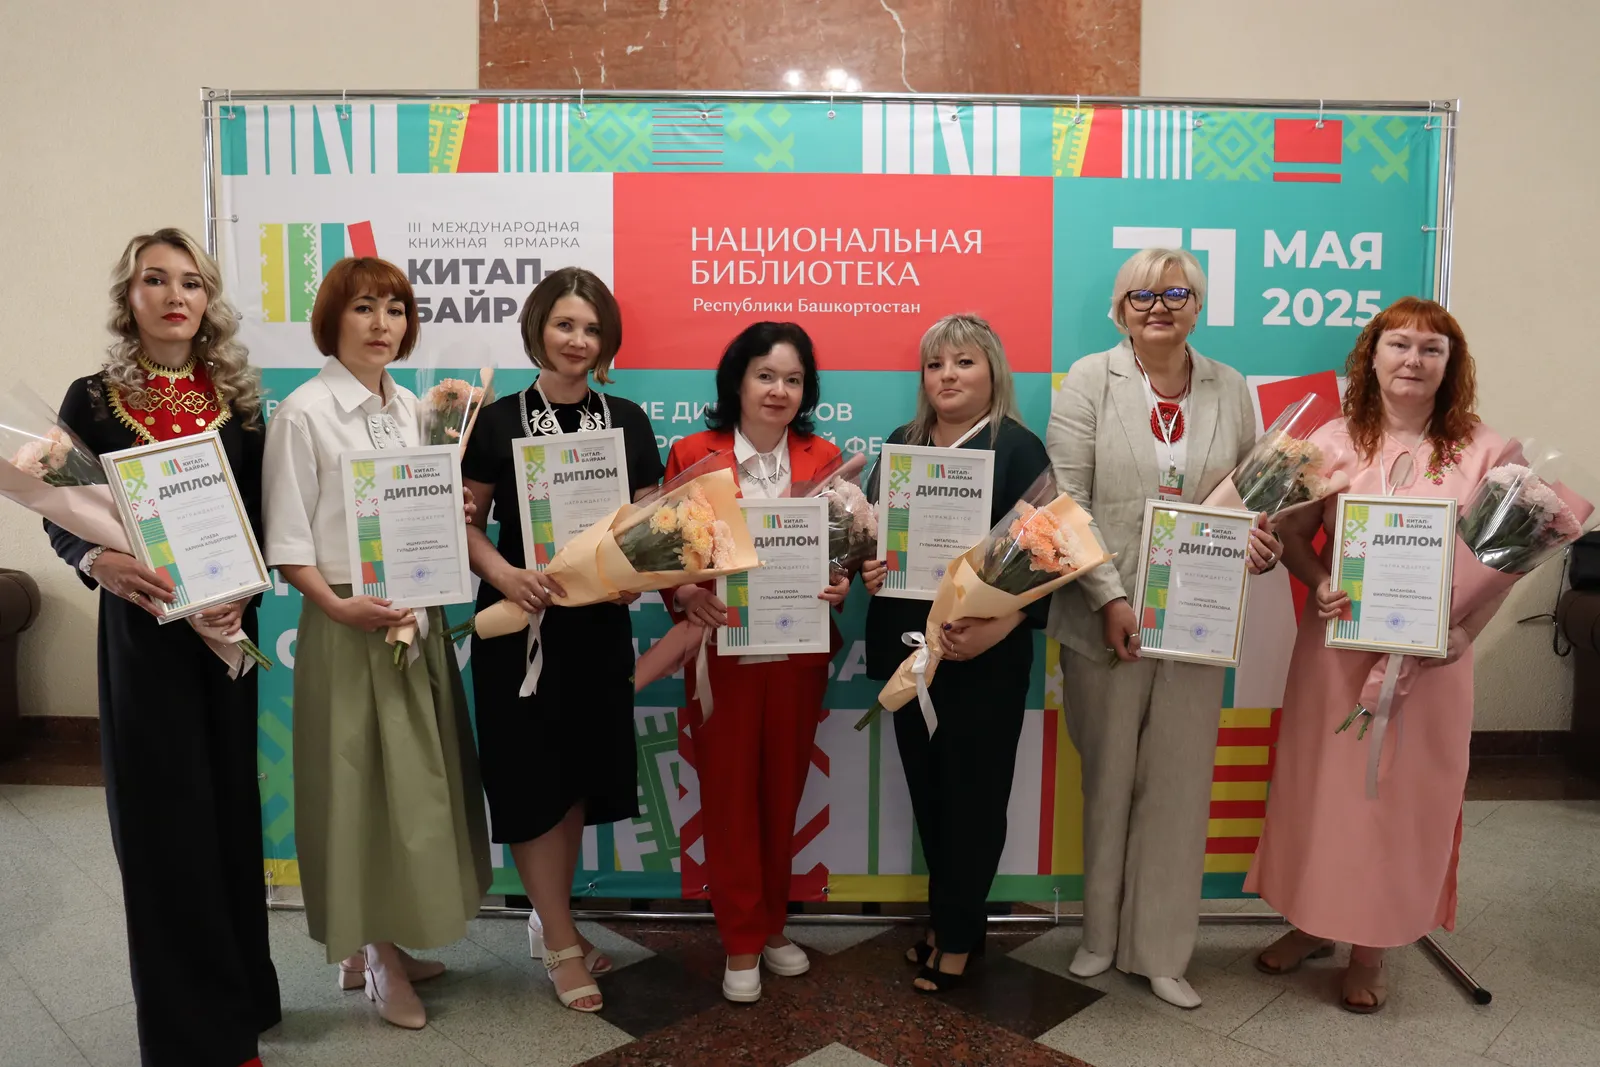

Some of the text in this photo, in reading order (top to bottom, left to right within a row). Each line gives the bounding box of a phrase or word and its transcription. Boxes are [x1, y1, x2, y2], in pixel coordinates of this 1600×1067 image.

[408, 221, 580, 234] III МЕЖДУНАРОДНАЯ
[408, 237, 580, 248] КНИЖНАЯ ЯРМАРКА
[691, 227, 982, 257] НАЦИОНАЛЬНАЯ
[1263, 229, 1383, 270] МАЯ
[408, 258, 556, 285] КИТАП-
[691, 260, 920, 286] БИБЛИОТЕКА
[416, 290, 524, 324] БАЙР
[693, 298, 920, 317] Республики Башкортостан
[1262, 288, 1382, 327] 2025
[184, 462, 210, 472] БАЙРАМ
[553, 467, 618, 485] ДИПЛОМ
[158, 472, 226, 500] ДИПЛОМ
[384, 484, 452, 501] ДИПЛОМ
[916, 485, 982, 499] ДИПЛОМ
[754, 536, 819, 548] ДИПЛОМ
[1372, 534, 1442, 548] ДИПЛОМ
[1178, 542, 1245, 559] ДИПЛОМ
